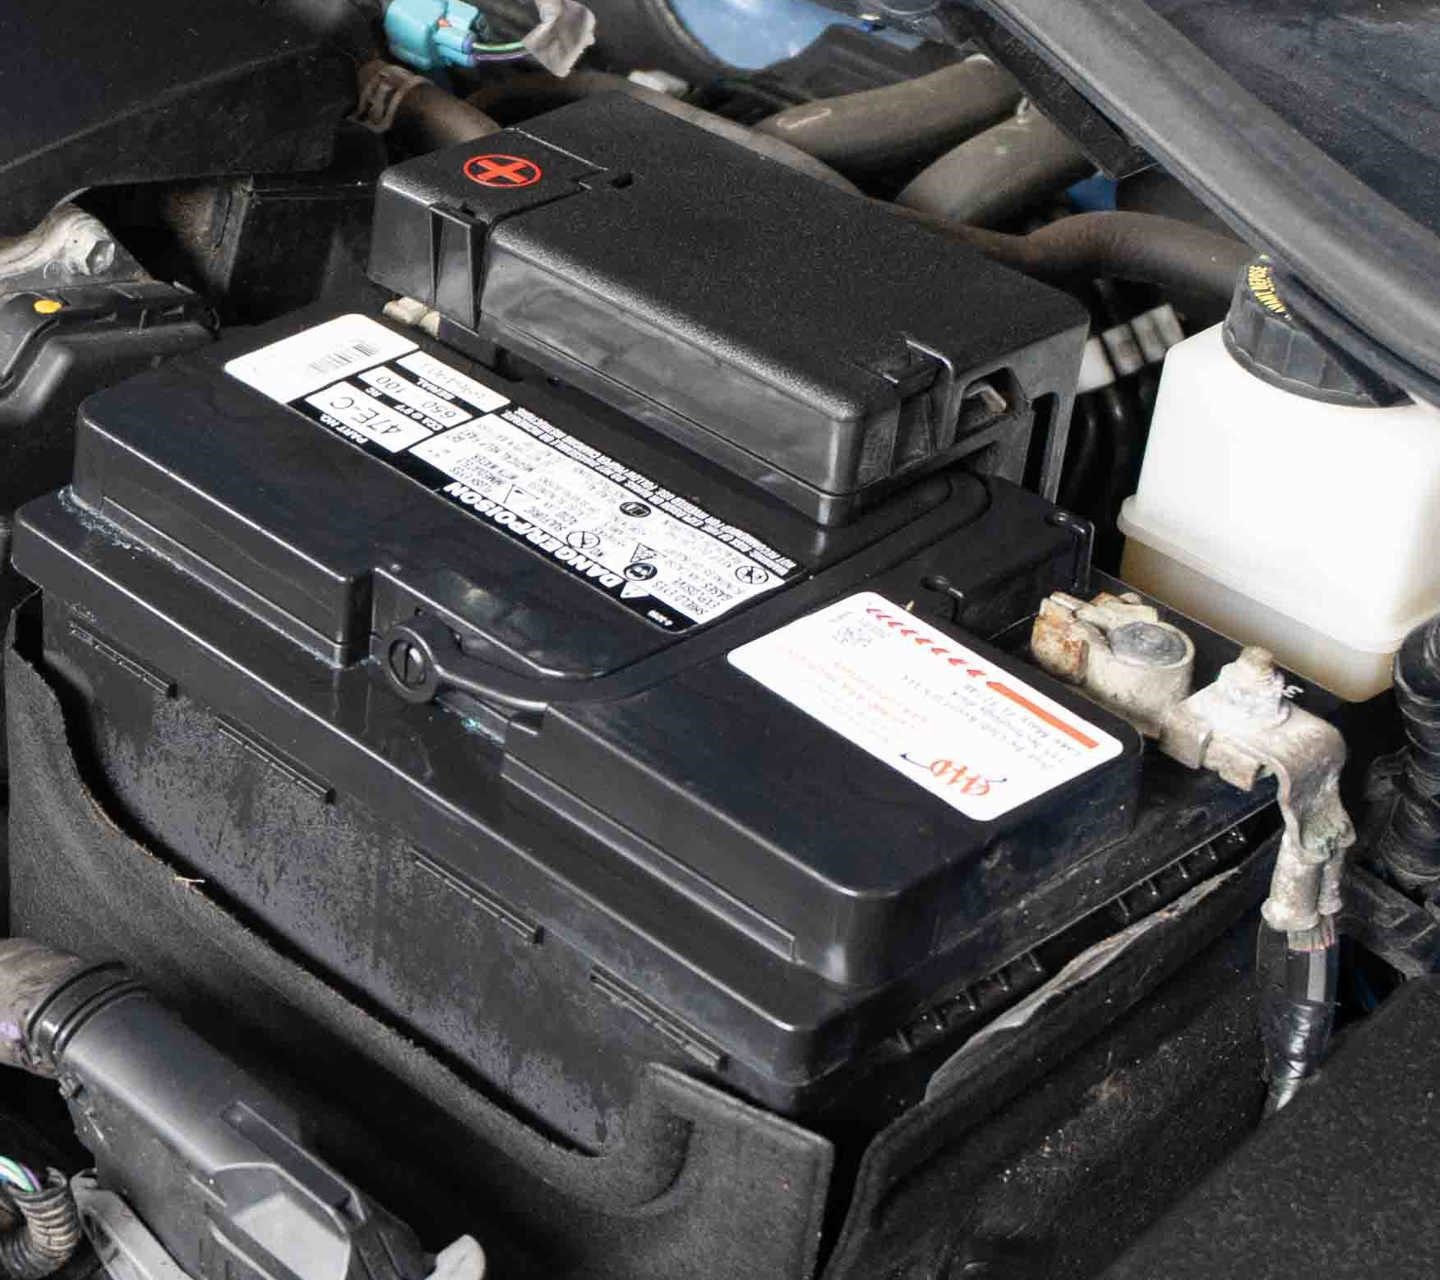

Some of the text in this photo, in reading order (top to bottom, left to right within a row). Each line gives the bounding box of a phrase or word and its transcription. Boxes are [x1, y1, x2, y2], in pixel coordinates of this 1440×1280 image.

[375, 375, 407, 394] 100
[417, 377, 458, 401] SERIAL
[328, 396, 402, 436] 47E-C
[420, 401, 457, 419] 650
[320, 412, 369, 443] PART NO.
[443, 481, 628, 588] DANGER/POISON
